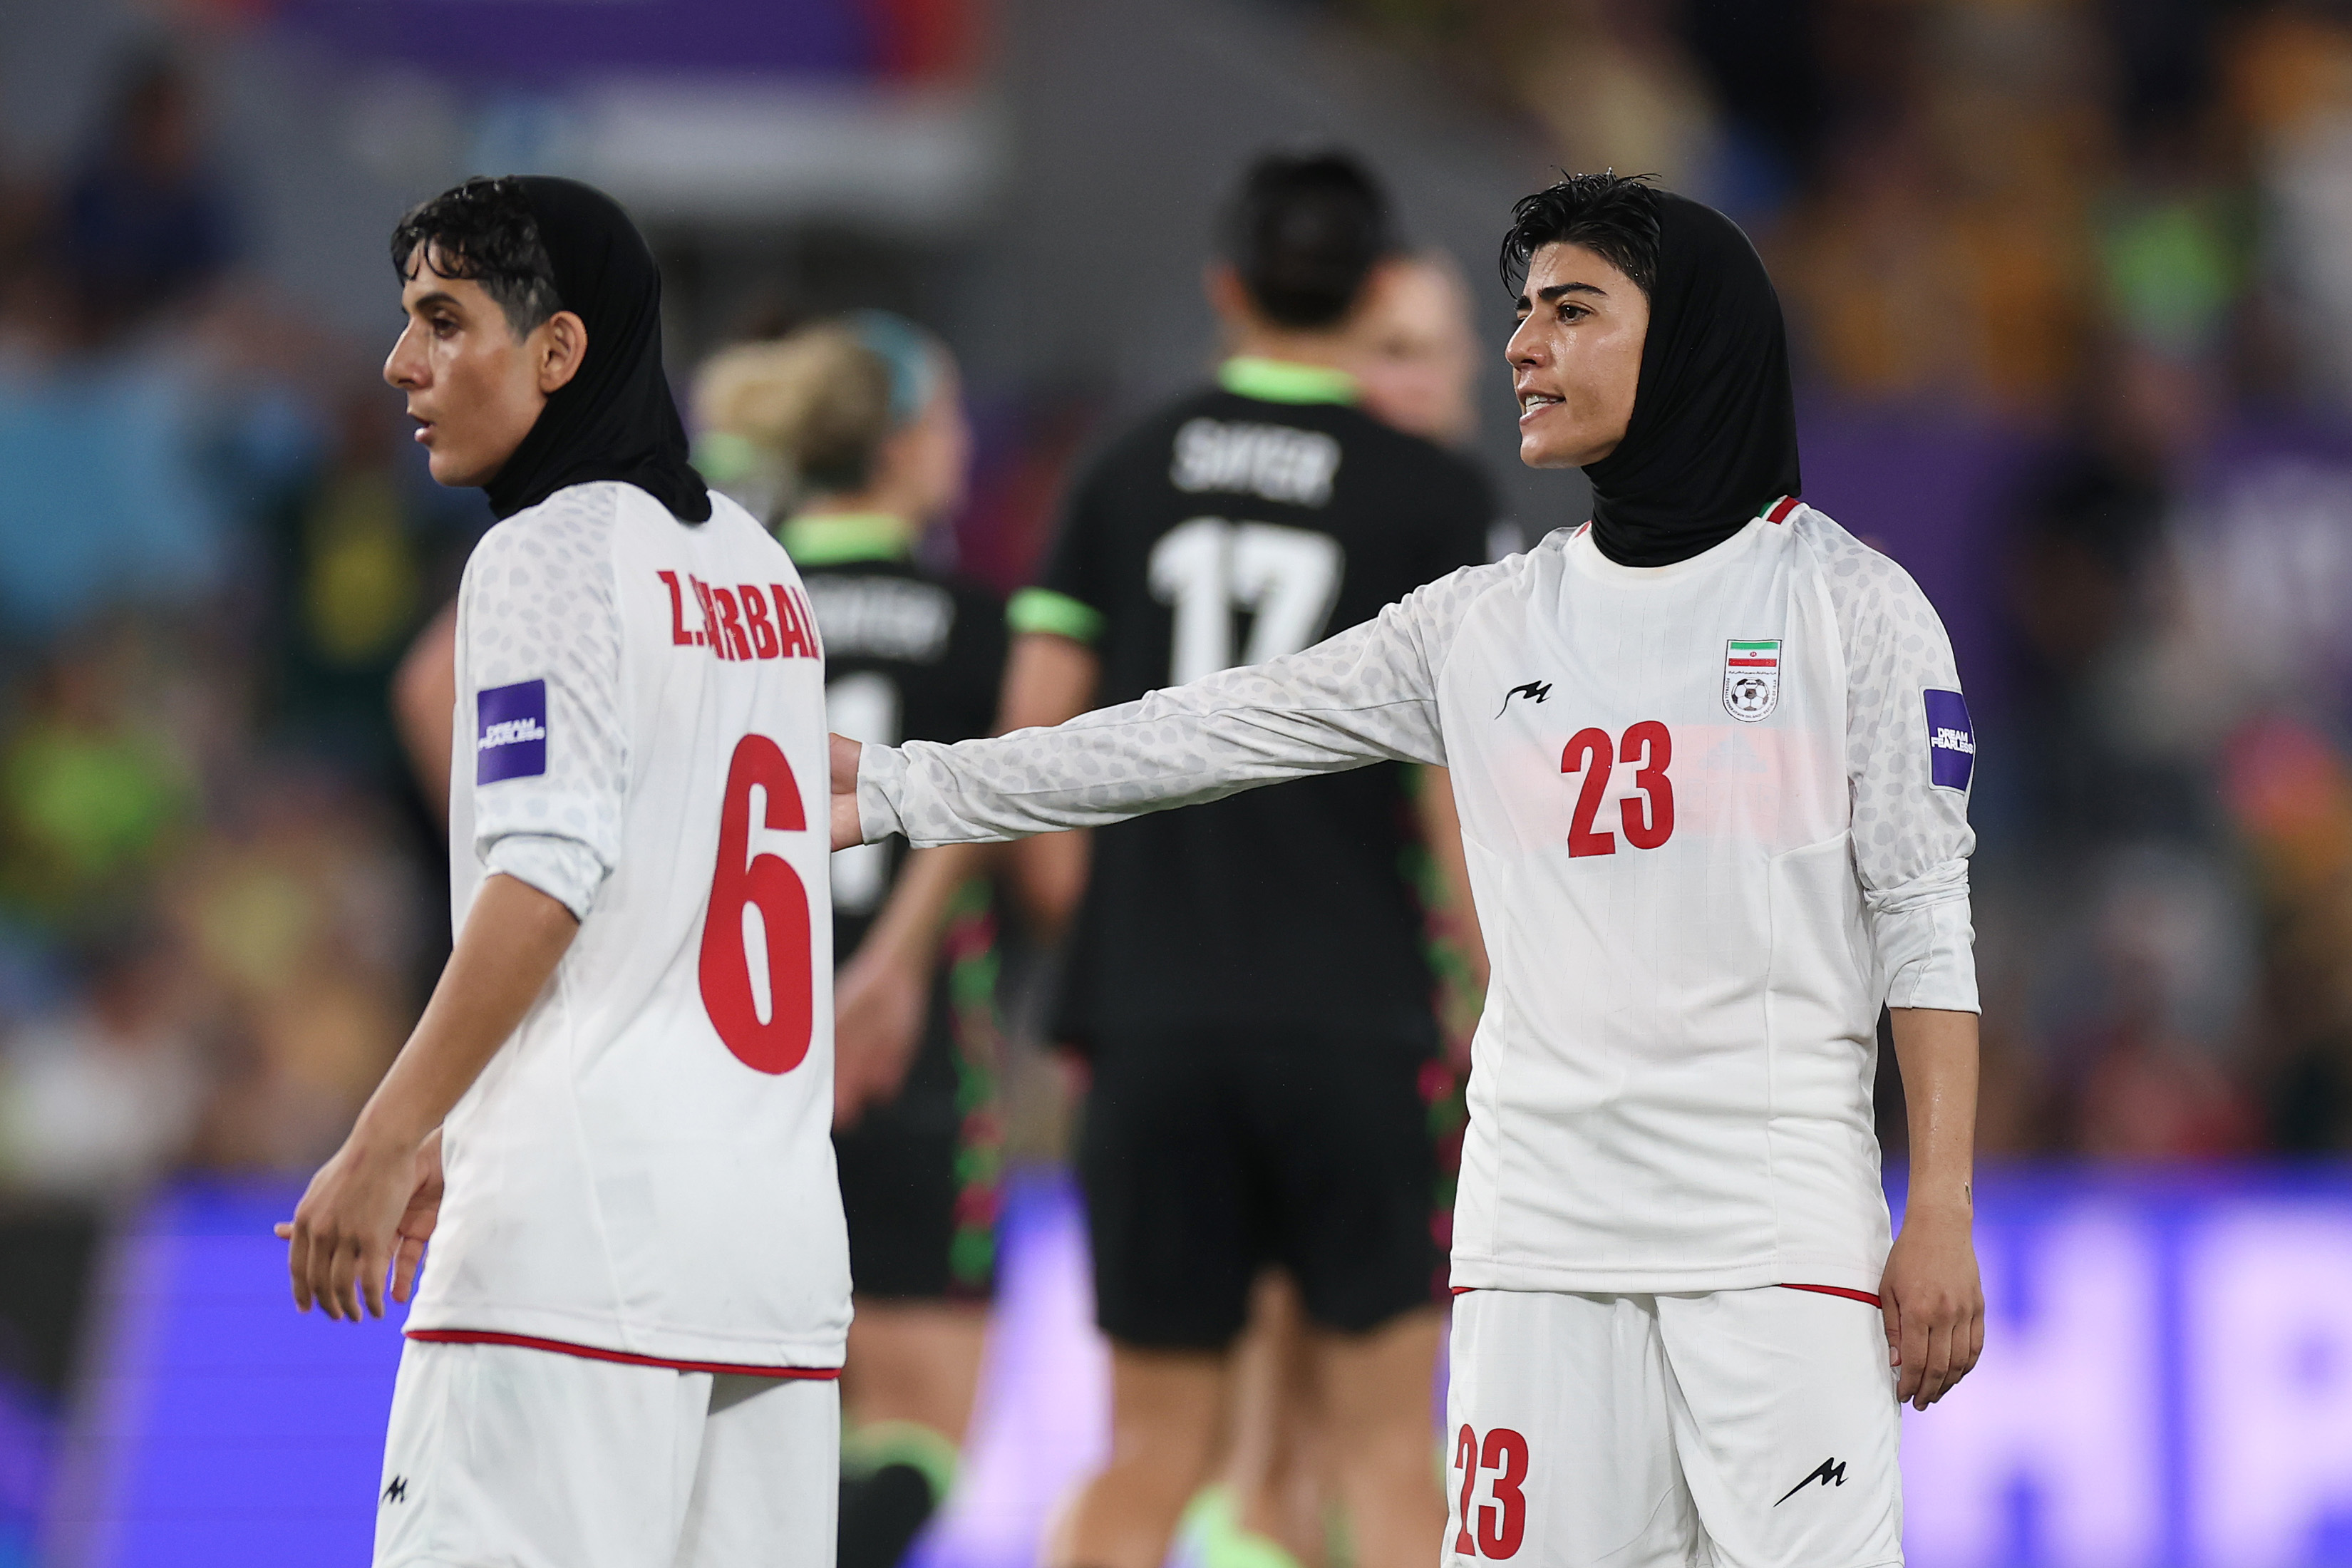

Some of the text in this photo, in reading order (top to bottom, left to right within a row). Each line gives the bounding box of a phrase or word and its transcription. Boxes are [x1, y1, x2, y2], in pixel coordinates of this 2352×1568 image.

[1147, 515, 1346, 686] 17
[1561, 721, 1674, 858] 23
[1931, 736, 1974, 755] FEARLESS
[1937, 728, 1968, 743] DREAM
[698, 732, 813, 1075] 6
[1454, 1423, 1529, 1560] 23
